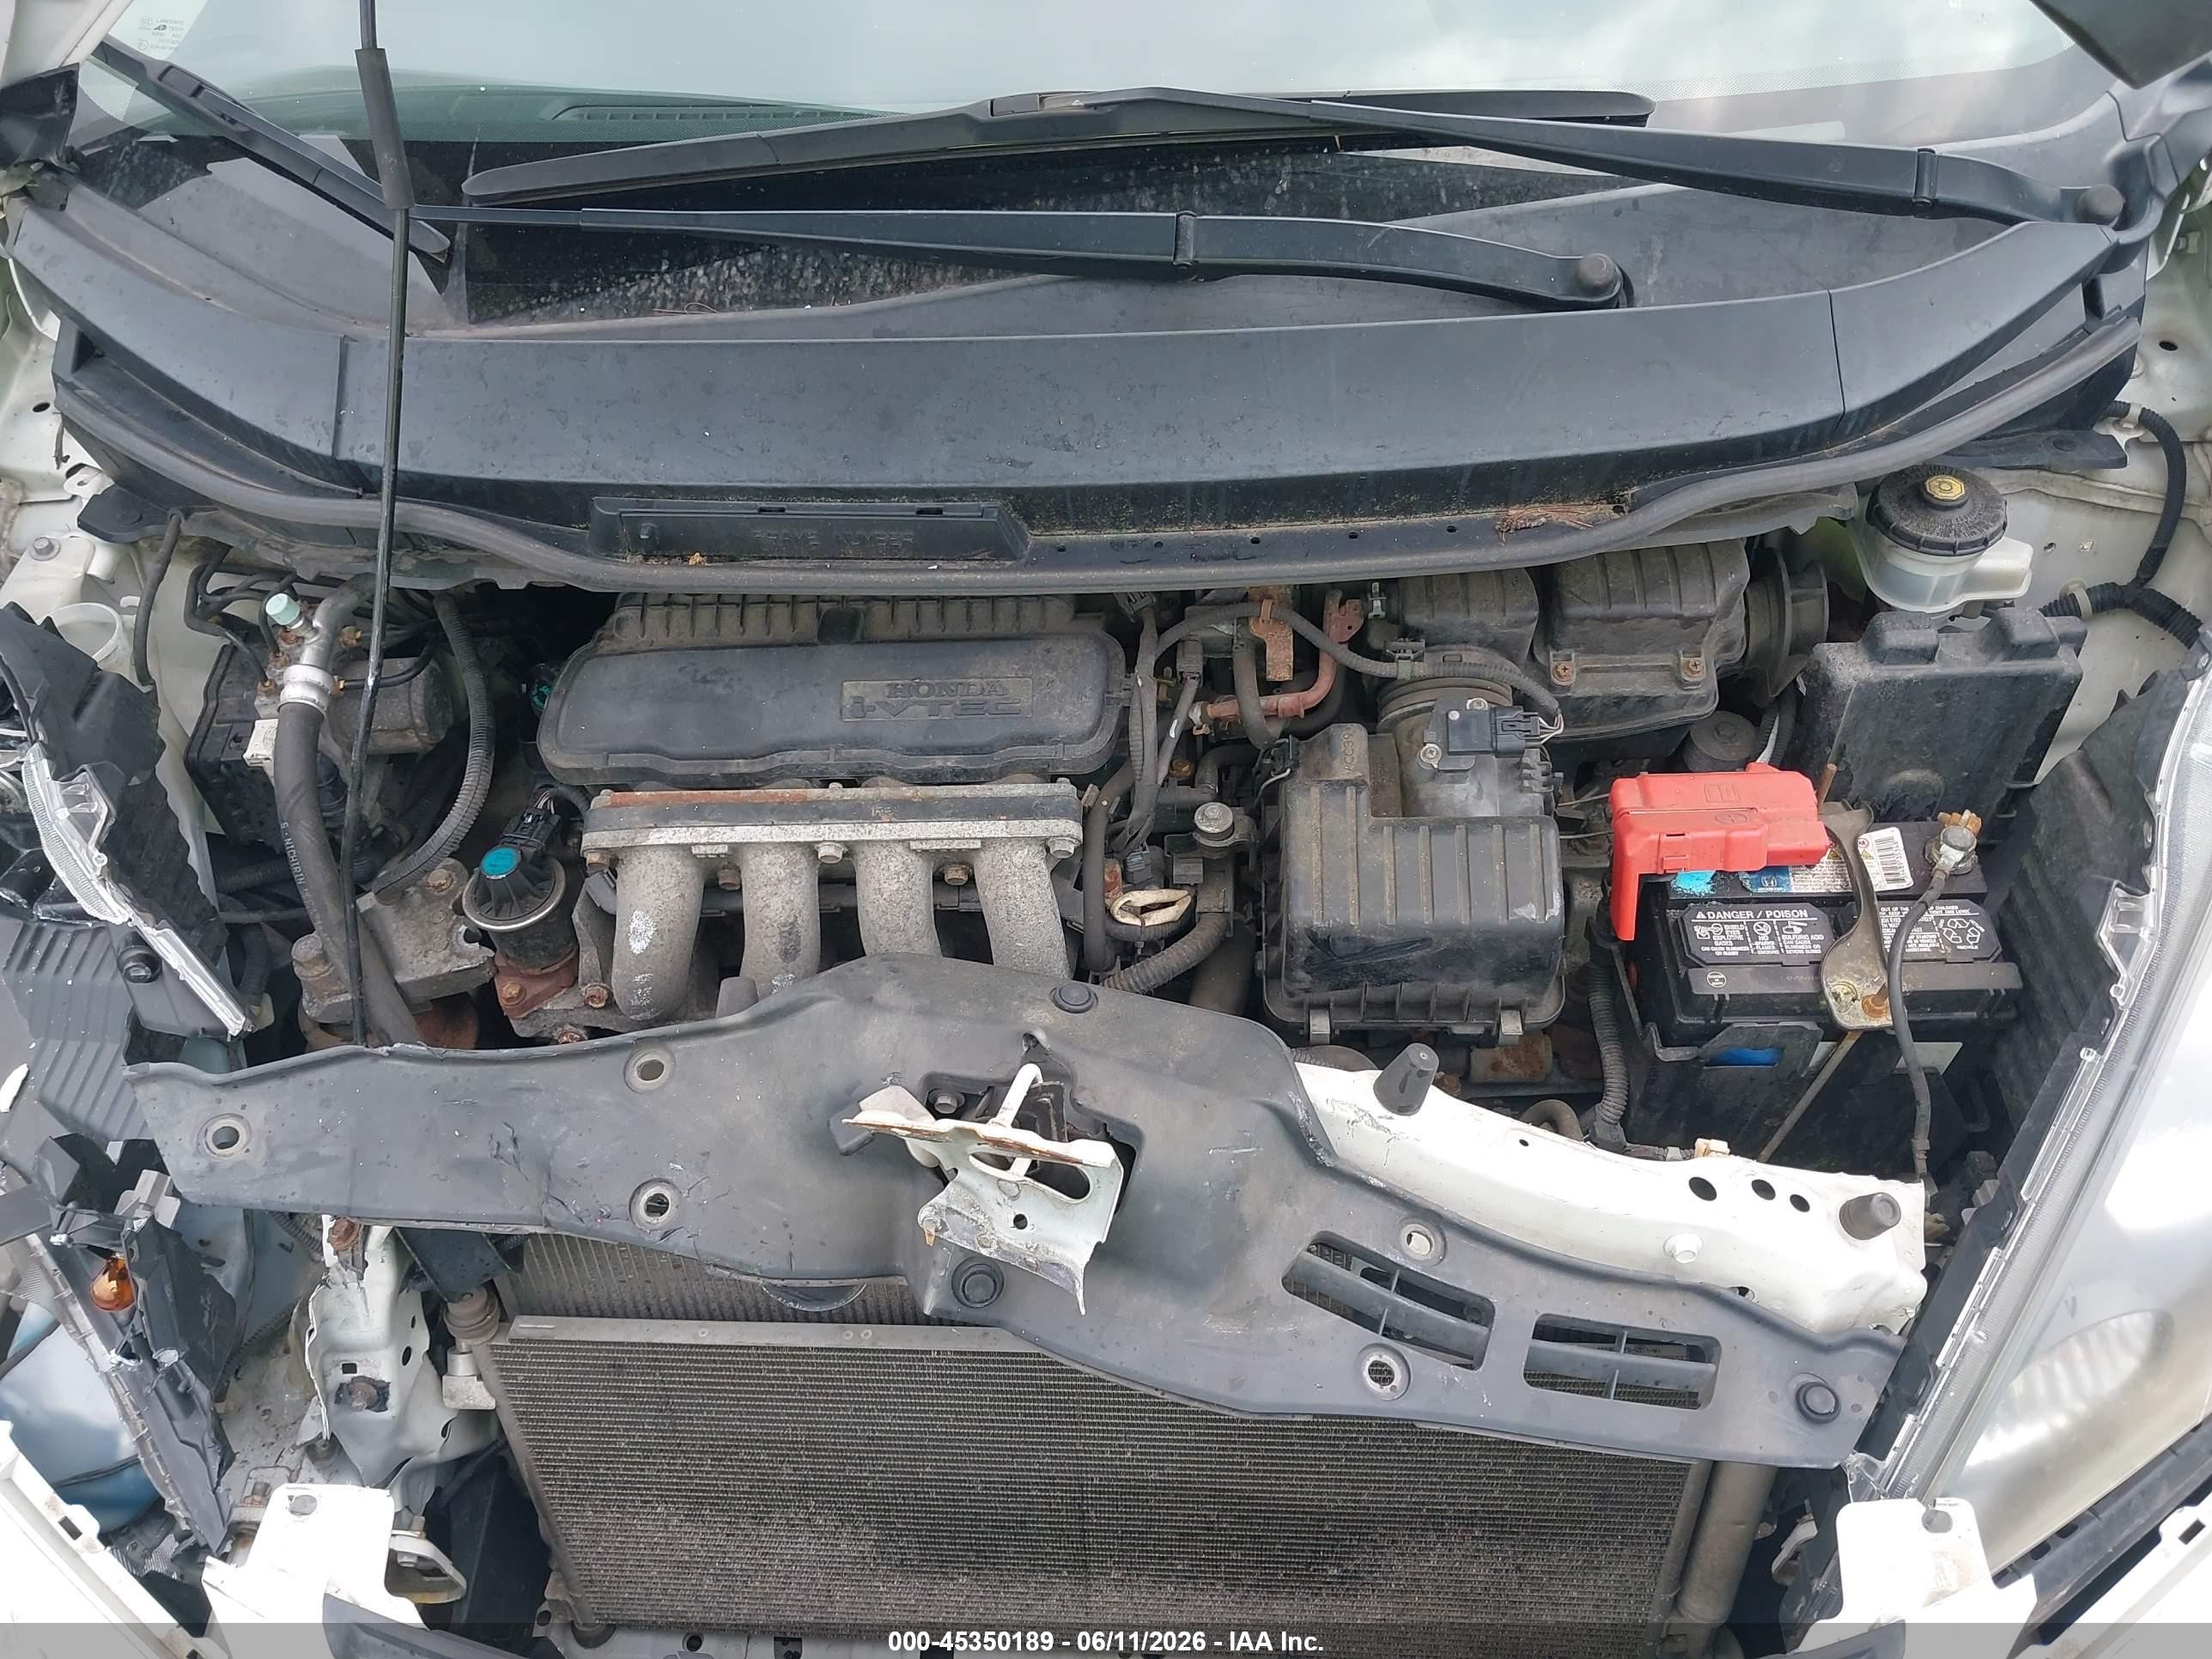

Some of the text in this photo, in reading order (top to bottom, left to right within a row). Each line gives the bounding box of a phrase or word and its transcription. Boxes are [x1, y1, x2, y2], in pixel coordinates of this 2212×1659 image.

[886, 682, 1010, 699] HONDA
[851, 696, 1021, 719] i-VTEC
[1707, 909, 1808, 920] DANGER / POISON
